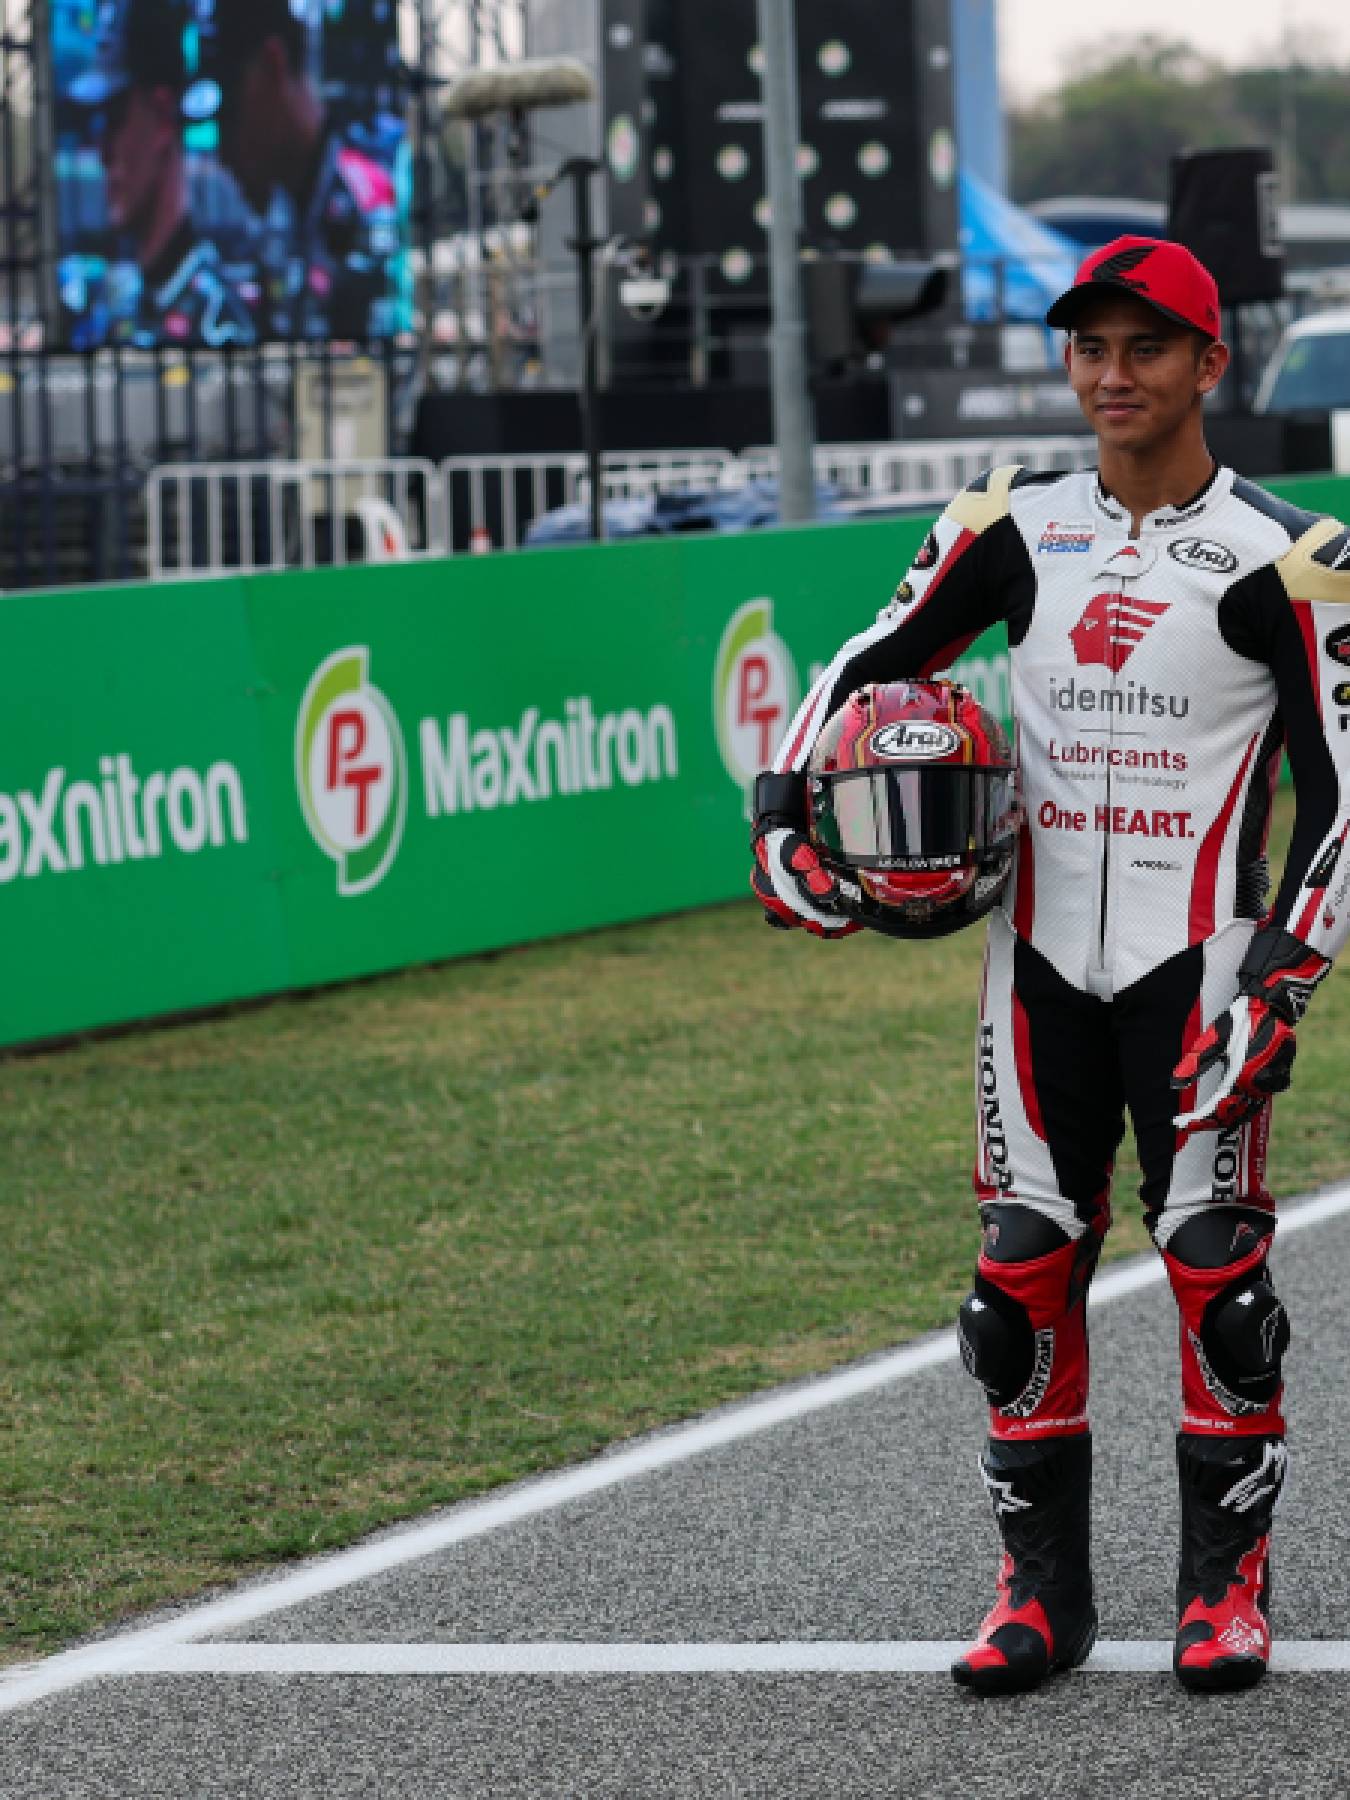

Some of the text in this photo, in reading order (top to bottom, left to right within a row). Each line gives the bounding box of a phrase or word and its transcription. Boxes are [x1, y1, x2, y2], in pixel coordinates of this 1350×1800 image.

[1049, 677, 1189, 718] idemitsu
[326, 710, 382, 837] PT
[419, 696, 679, 817] Maxnitron
[1048, 739, 1189, 772] Lubricants
[1038, 800, 1195, 838] One HEART.
[980, 1023, 1013, 1191] HONDA
